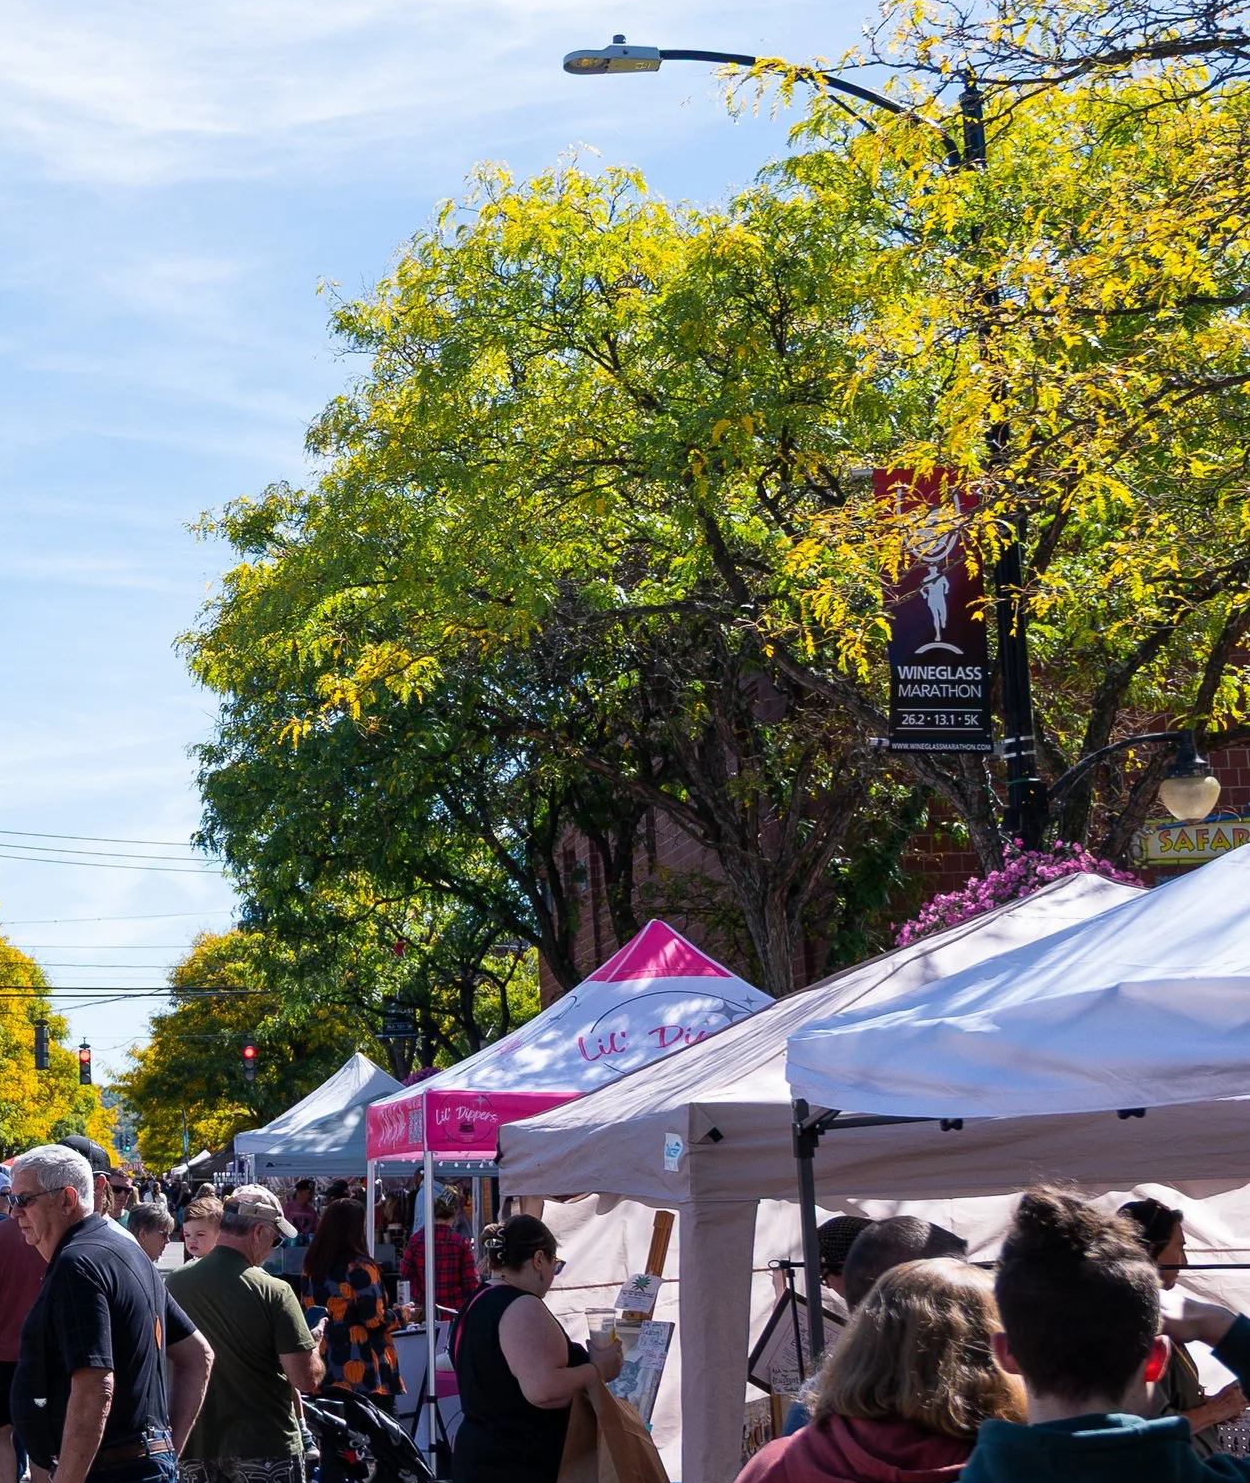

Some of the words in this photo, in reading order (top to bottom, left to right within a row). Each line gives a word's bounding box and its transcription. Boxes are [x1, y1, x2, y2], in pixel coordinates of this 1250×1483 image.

[897, 665, 982, 680] WINEGLASS
[898, 684, 982, 698] MARATHON
[901, 713, 925, 725] 26.2
[934, 714, 955, 725] 13.1
[964, 714, 979, 726] 5K
[891, 742, 992, 751] WWW.WINEGLASSMARATHON.COM
[578, 1031, 626, 1062] Lil'
[435, 1108, 451, 1125] Lil'
[456, 1105, 499, 1123] Dippers
